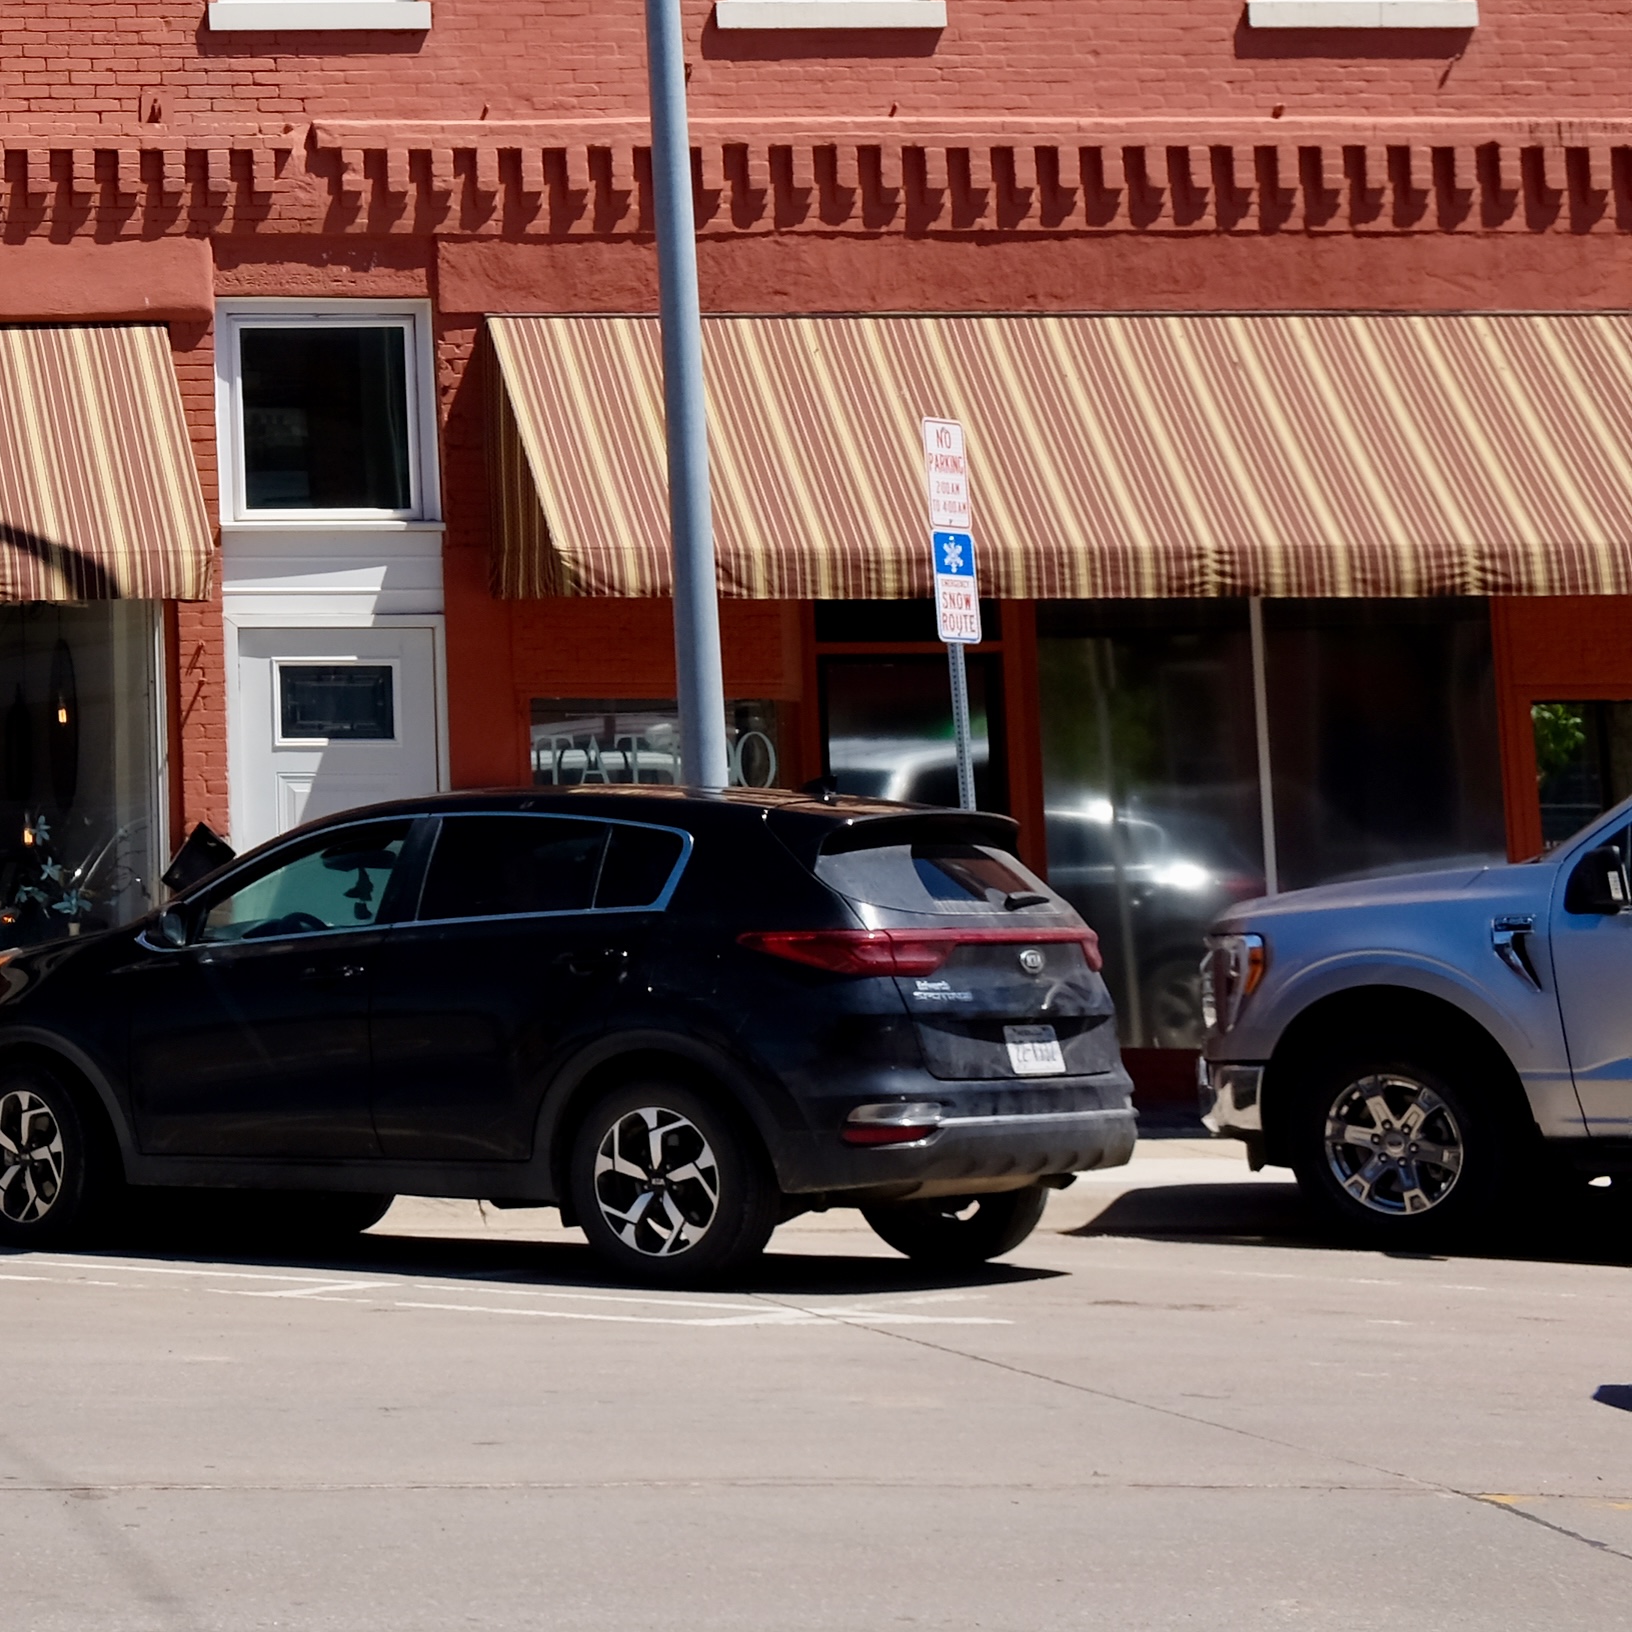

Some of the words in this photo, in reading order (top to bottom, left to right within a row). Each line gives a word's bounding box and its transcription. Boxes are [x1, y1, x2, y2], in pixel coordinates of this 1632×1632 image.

[936, 428, 951, 448] NO
[928, 453, 963, 474] PARKING
[942, 592, 972, 610] SNOW
[942, 613, 976, 633] ROUTE
[533, 731, 777, 788] TATTO
